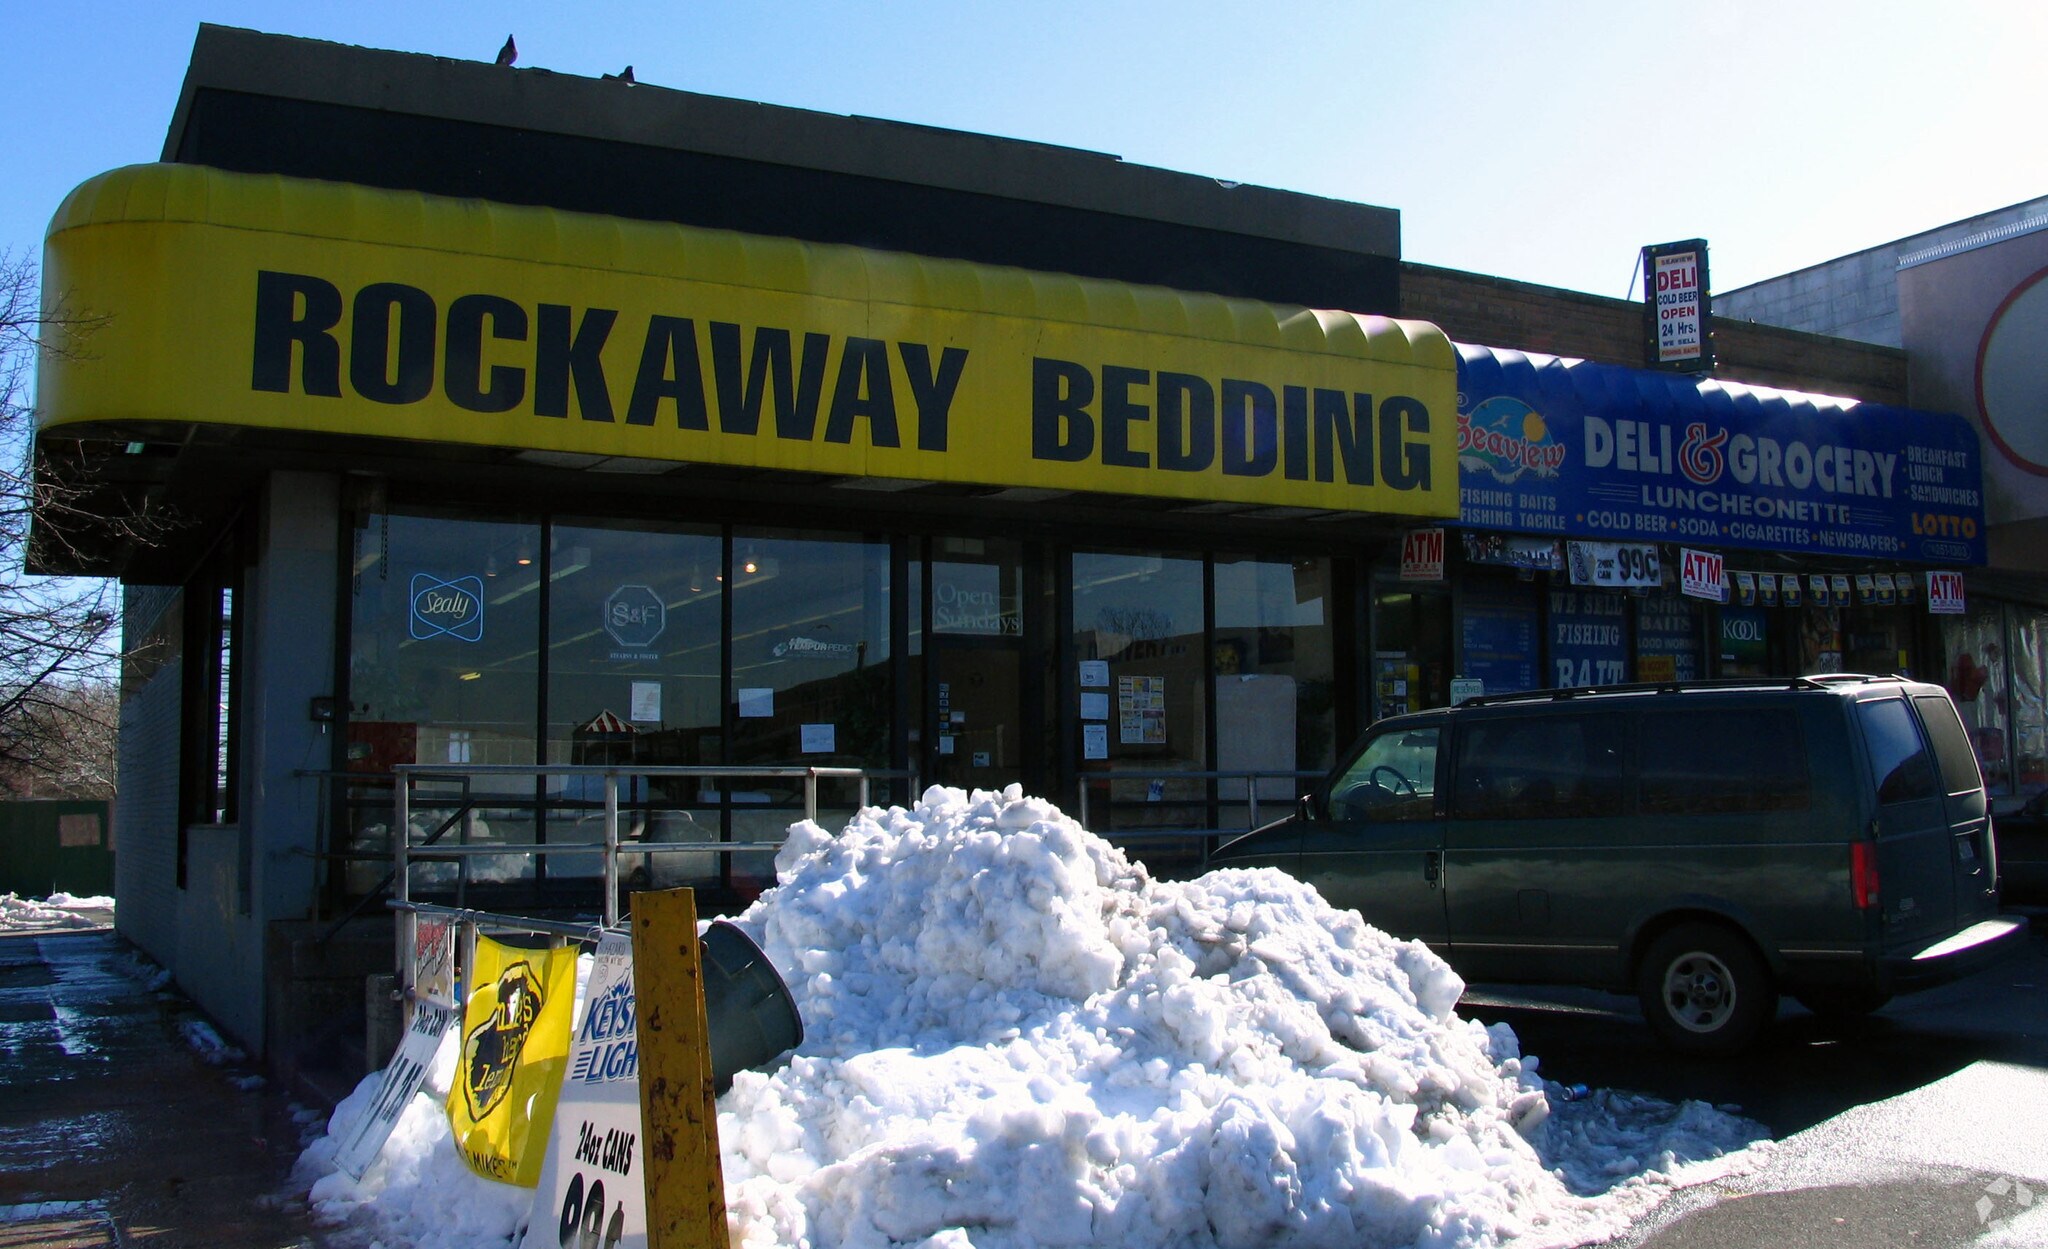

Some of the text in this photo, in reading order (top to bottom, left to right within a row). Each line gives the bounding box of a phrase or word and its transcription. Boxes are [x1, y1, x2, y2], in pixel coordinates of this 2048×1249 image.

[1657, 267, 1696, 291] DELI
[1658, 291, 1698, 305] COLD BEER
[1661, 306, 1695, 320] OPEN
[1662, 322, 1697, 337] 24 Hrs.
[1678, 338, 1696, 346] SELL
[252, 271, 969, 452] ROCKAWAY
[1032, 356, 1431, 491] BEDDING
[1584, 415, 1897, 498] DELI & GROCERY
[1907, 445, 1967, 469] BREAKFAST
[1909, 463, 1944, 484] LUNCH
[1459, 488, 1556, 511] FISHING BAITS
[1641, 484, 1850, 525] LUNCHEONETTE
[1910, 484, 1979, 507] SANDWICHES
[1460, 507, 1566, 530] FISHING TACKLE
[1911, 511, 1977, 539] LOTTO
[1587, 510, 1630, 529] COLD
[1634, 512, 1667, 533] BEER
[1679, 517, 1719, 537] SODA
[1730, 521, 1810, 545] CIGARETTES
[1819, 530, 1899, 552] NEWSPAPERS
[1403, 533, 1442, 563] ATM
[1617, 548, 1659, 582] 99¢
[1683, 553, 1722, 586] ATM
[937, 584, 994, 606] Open
[1930, 575, 1963, 599] ATM
[421, 592, 470, 619] Sealy
[1550, 591, 1576, 614] WE
[1583, 592, 1624, 616] SELL
[936, 607, 1020, 634] Sundays
[1723, 619, 1762, 641] KOOL
[1556, 623, 1620, 647] FISHING
[1556, 658, 1624, 688] BAIT
[575, 1120, 635, 1176] 24oz CANS
